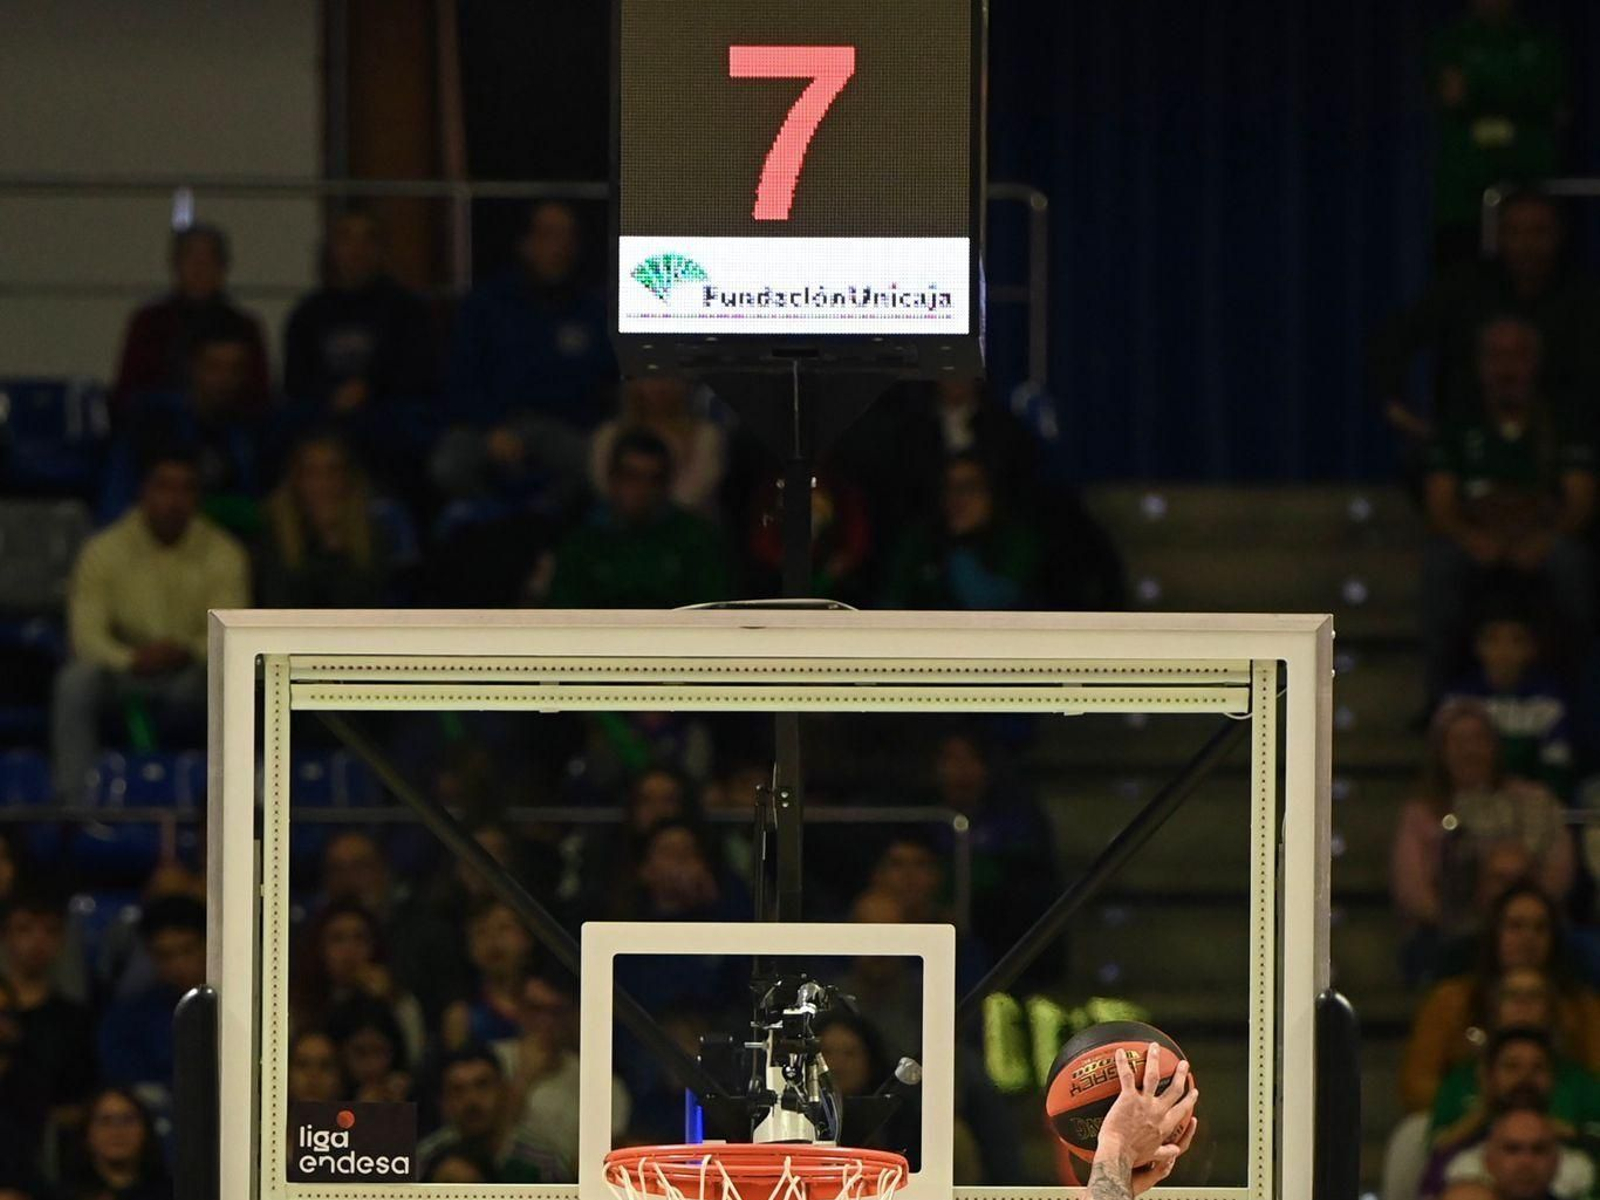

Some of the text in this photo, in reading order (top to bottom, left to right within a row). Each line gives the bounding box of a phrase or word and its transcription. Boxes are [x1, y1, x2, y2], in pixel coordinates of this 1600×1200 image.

[729, 45, 856, 221] 7
[299, 1123, 349, 1152] liga
[299, 1150, 410, 1175] endesa
